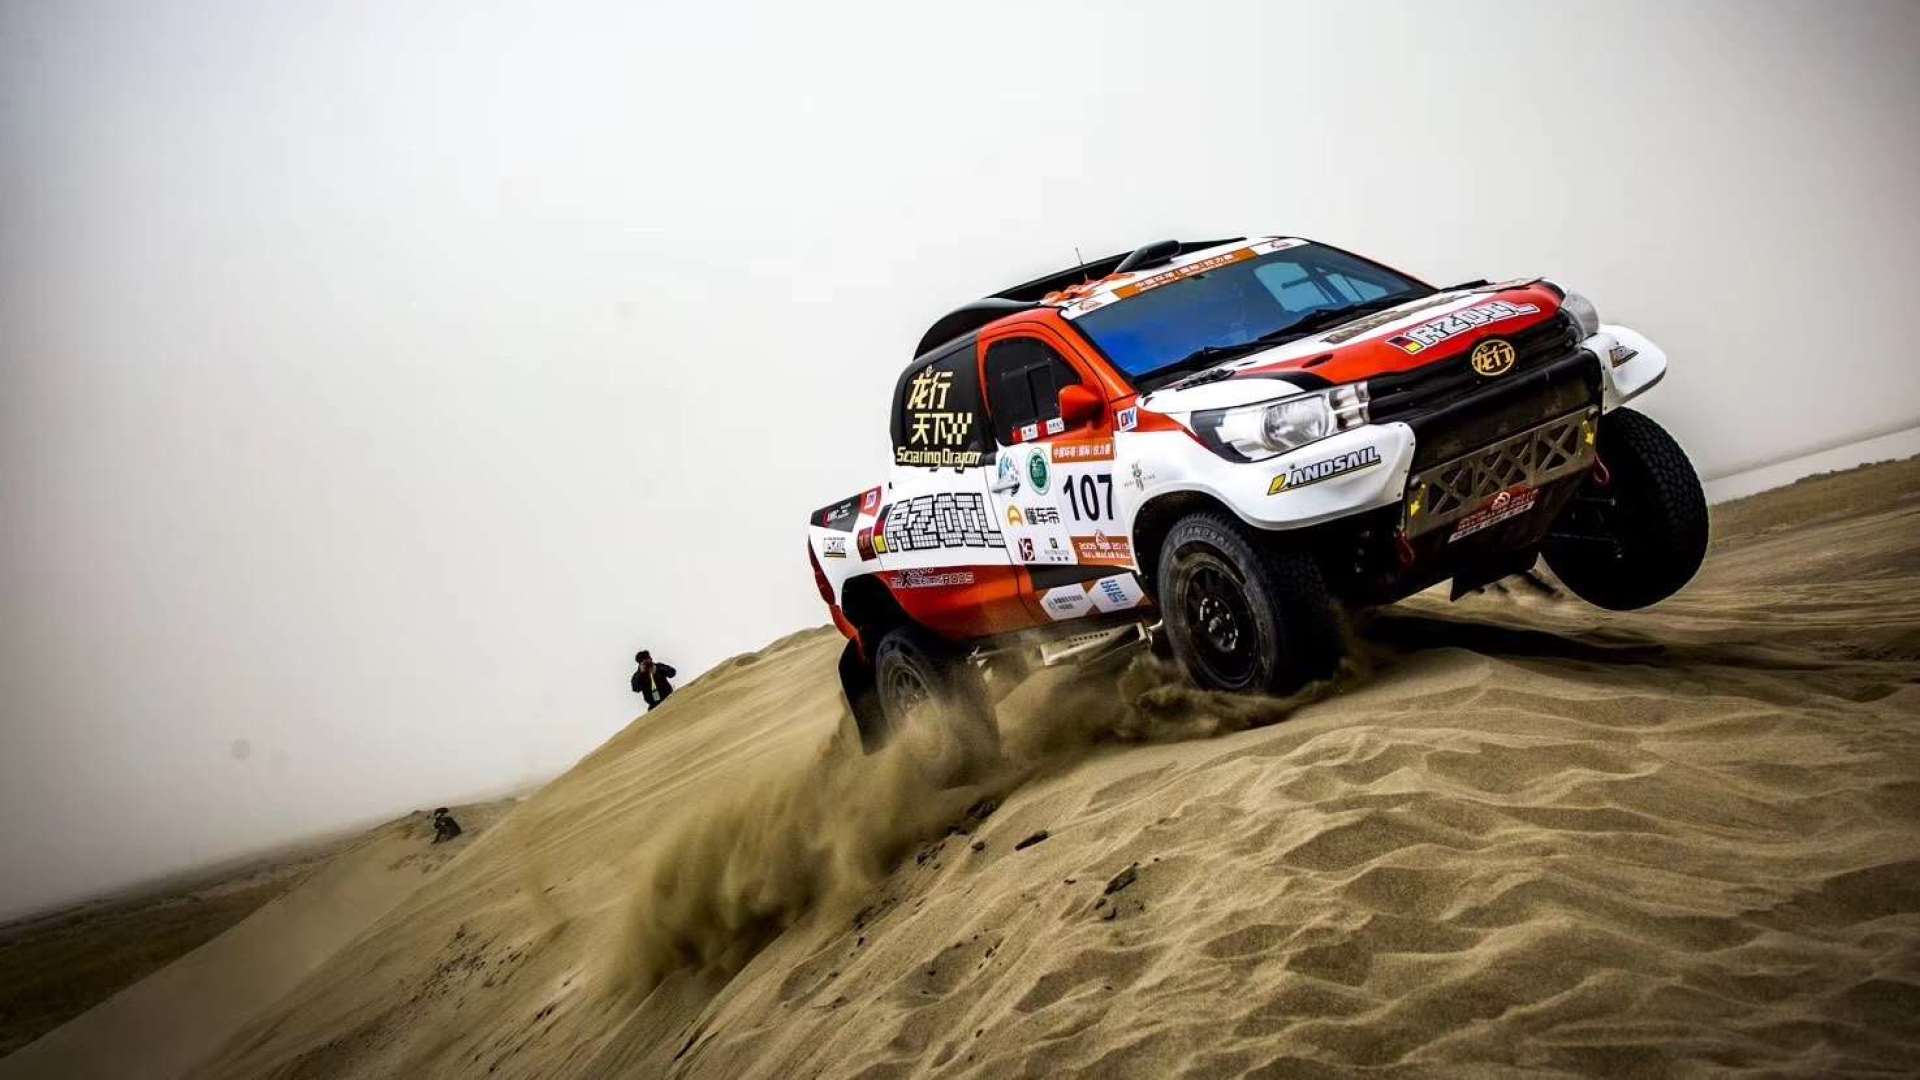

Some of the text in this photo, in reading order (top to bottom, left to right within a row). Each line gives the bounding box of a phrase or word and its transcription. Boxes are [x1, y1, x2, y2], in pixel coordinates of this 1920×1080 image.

[907, 364, 953, 409] 龙行
[896, 446, 940, 470] Soaring
[942, 448, 982, 471] Dragon
[1267, 446, 1382, 495] LANDSAIL
[1063, 474, 1114, 521] 107
[885, 493, 1006, 553] RZOIL
